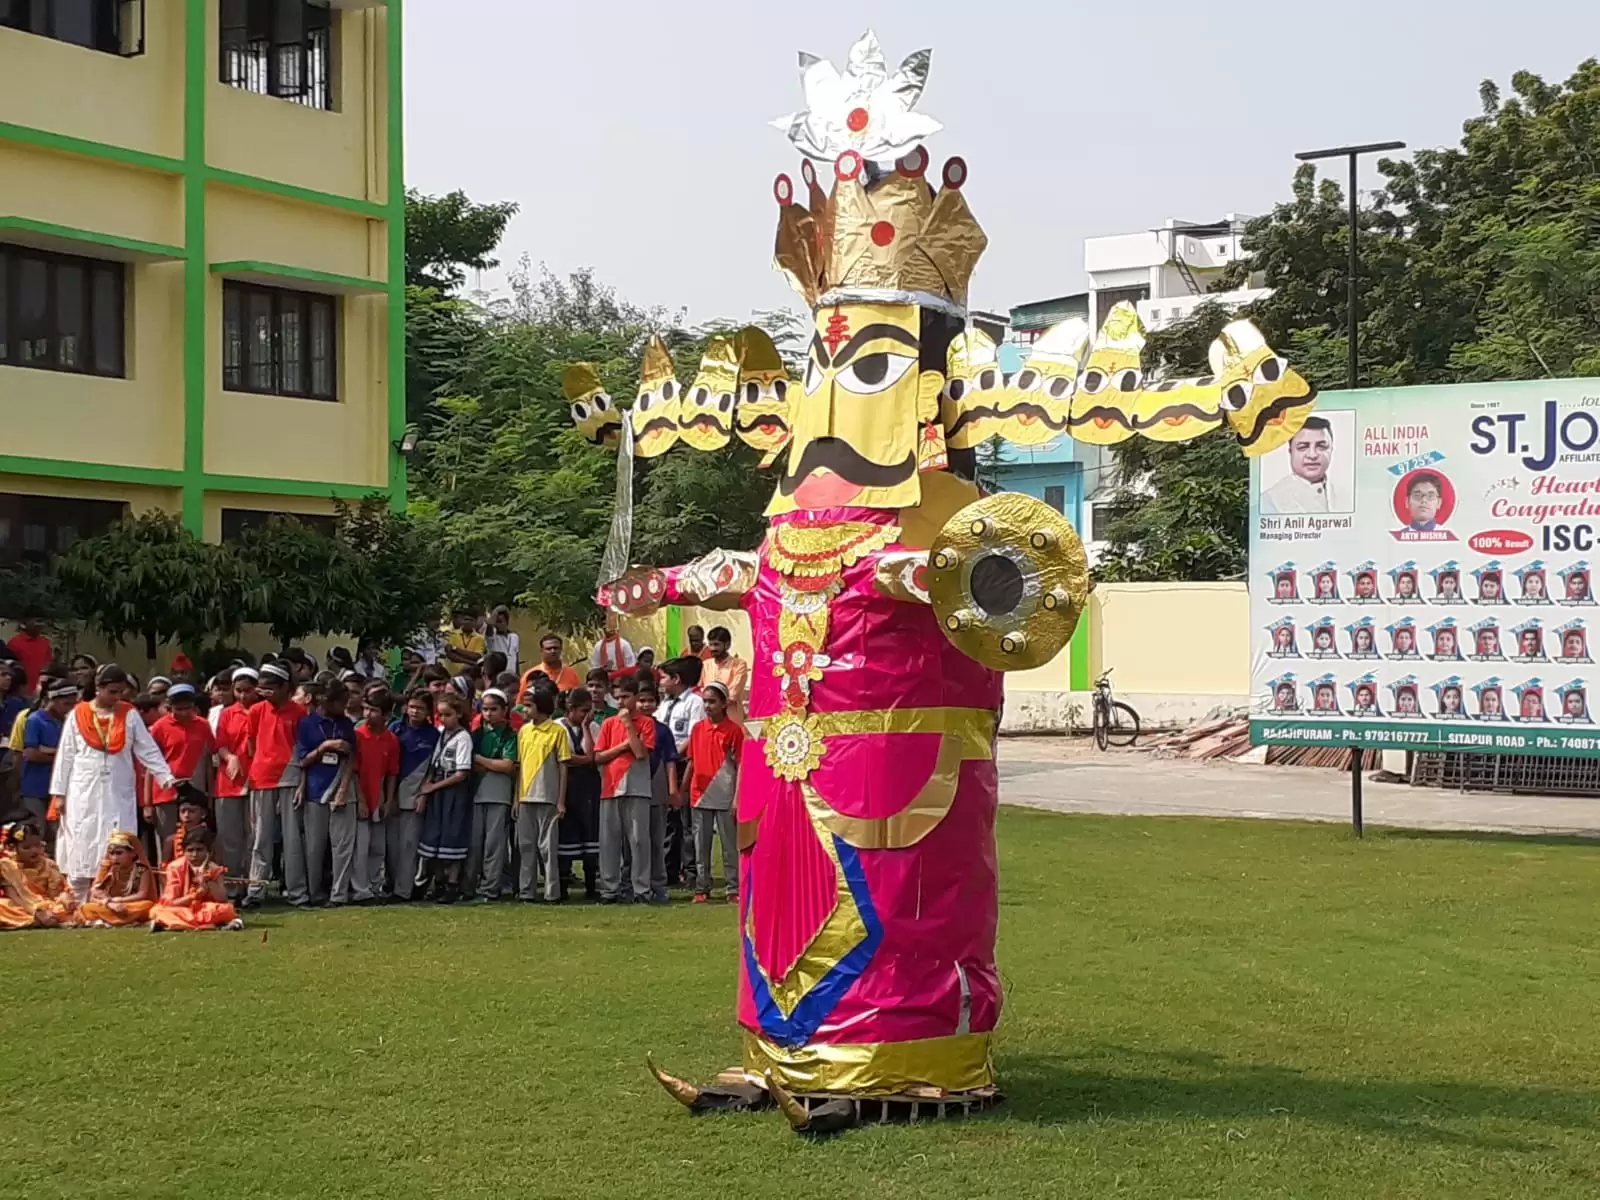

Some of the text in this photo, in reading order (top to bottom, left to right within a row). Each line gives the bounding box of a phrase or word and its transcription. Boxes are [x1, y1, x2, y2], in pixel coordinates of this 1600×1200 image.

[1364, 426, 1429, 440] ALL INDIA
[1365, 442, 1419, 456] RANK 11
[1260, 516, 1352, 530] Shri Anil Agarwal
[1260, 531, 1321, 540] Managing Director
[1420, 532, 1447, 540] MISHRA
[1473, 537, 1529, 548] 100% Result
[1448, 733, 1493, 746] SITAPUR
[1496, 736, 1525, 748] ROAD
